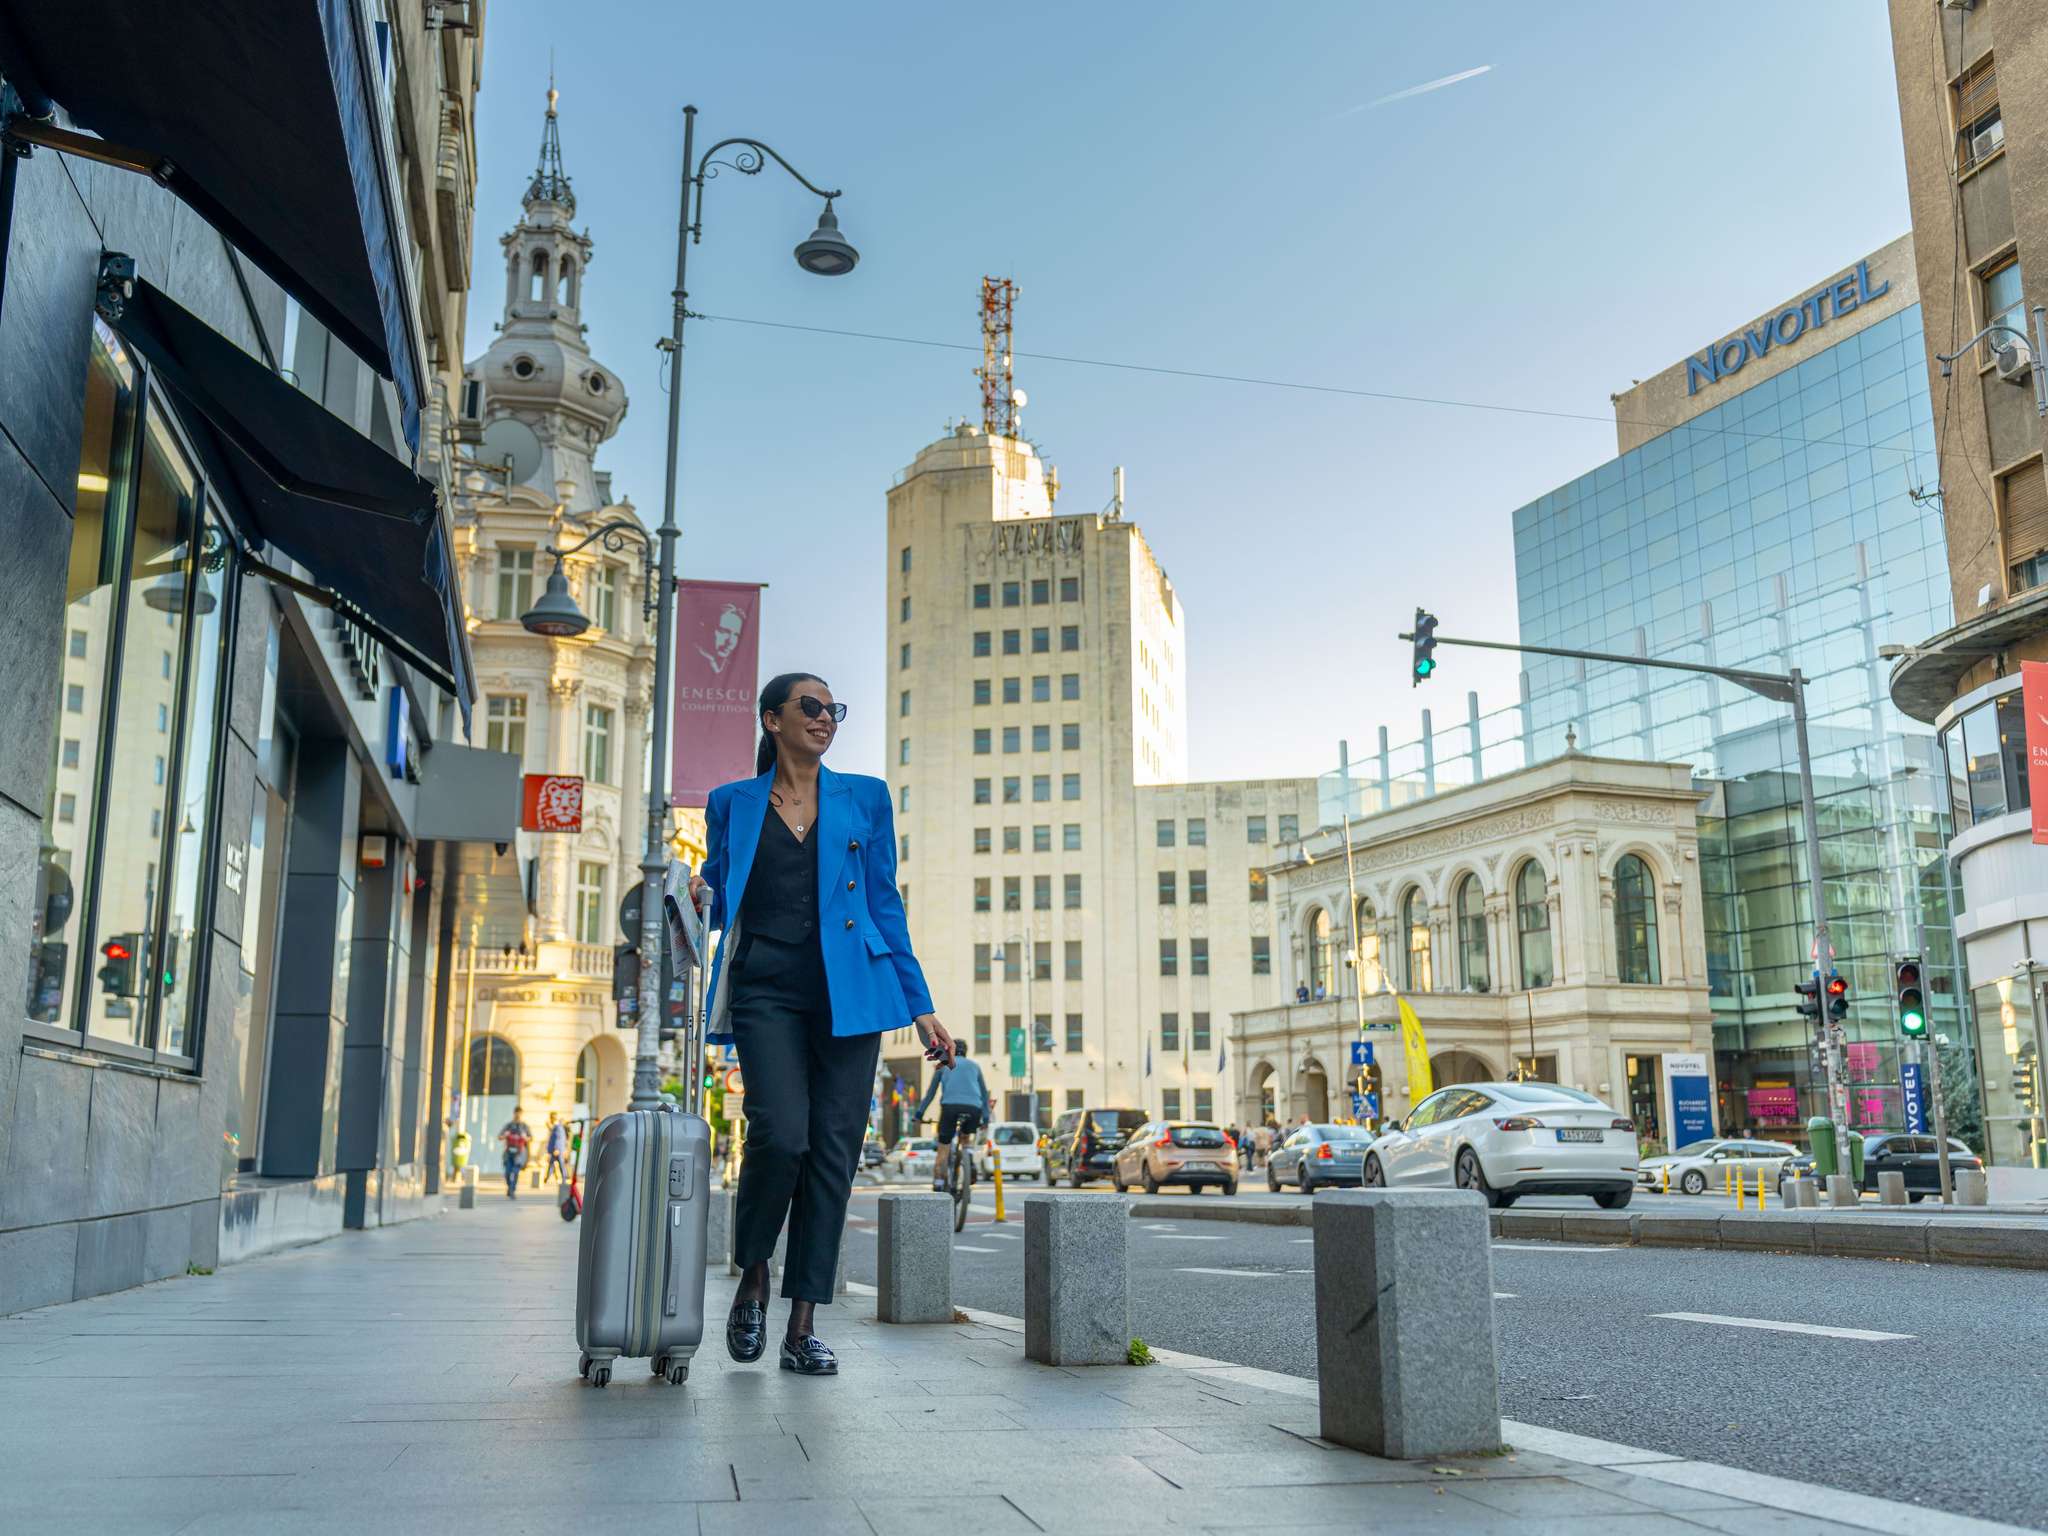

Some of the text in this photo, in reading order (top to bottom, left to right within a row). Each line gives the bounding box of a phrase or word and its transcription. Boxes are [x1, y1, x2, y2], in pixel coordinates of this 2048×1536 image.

[1686, 260, 1889, 396] NOVOTEL
[681, 687, 750, 702] ENESCU
[681, 702, 750, 713] COMPETITION
